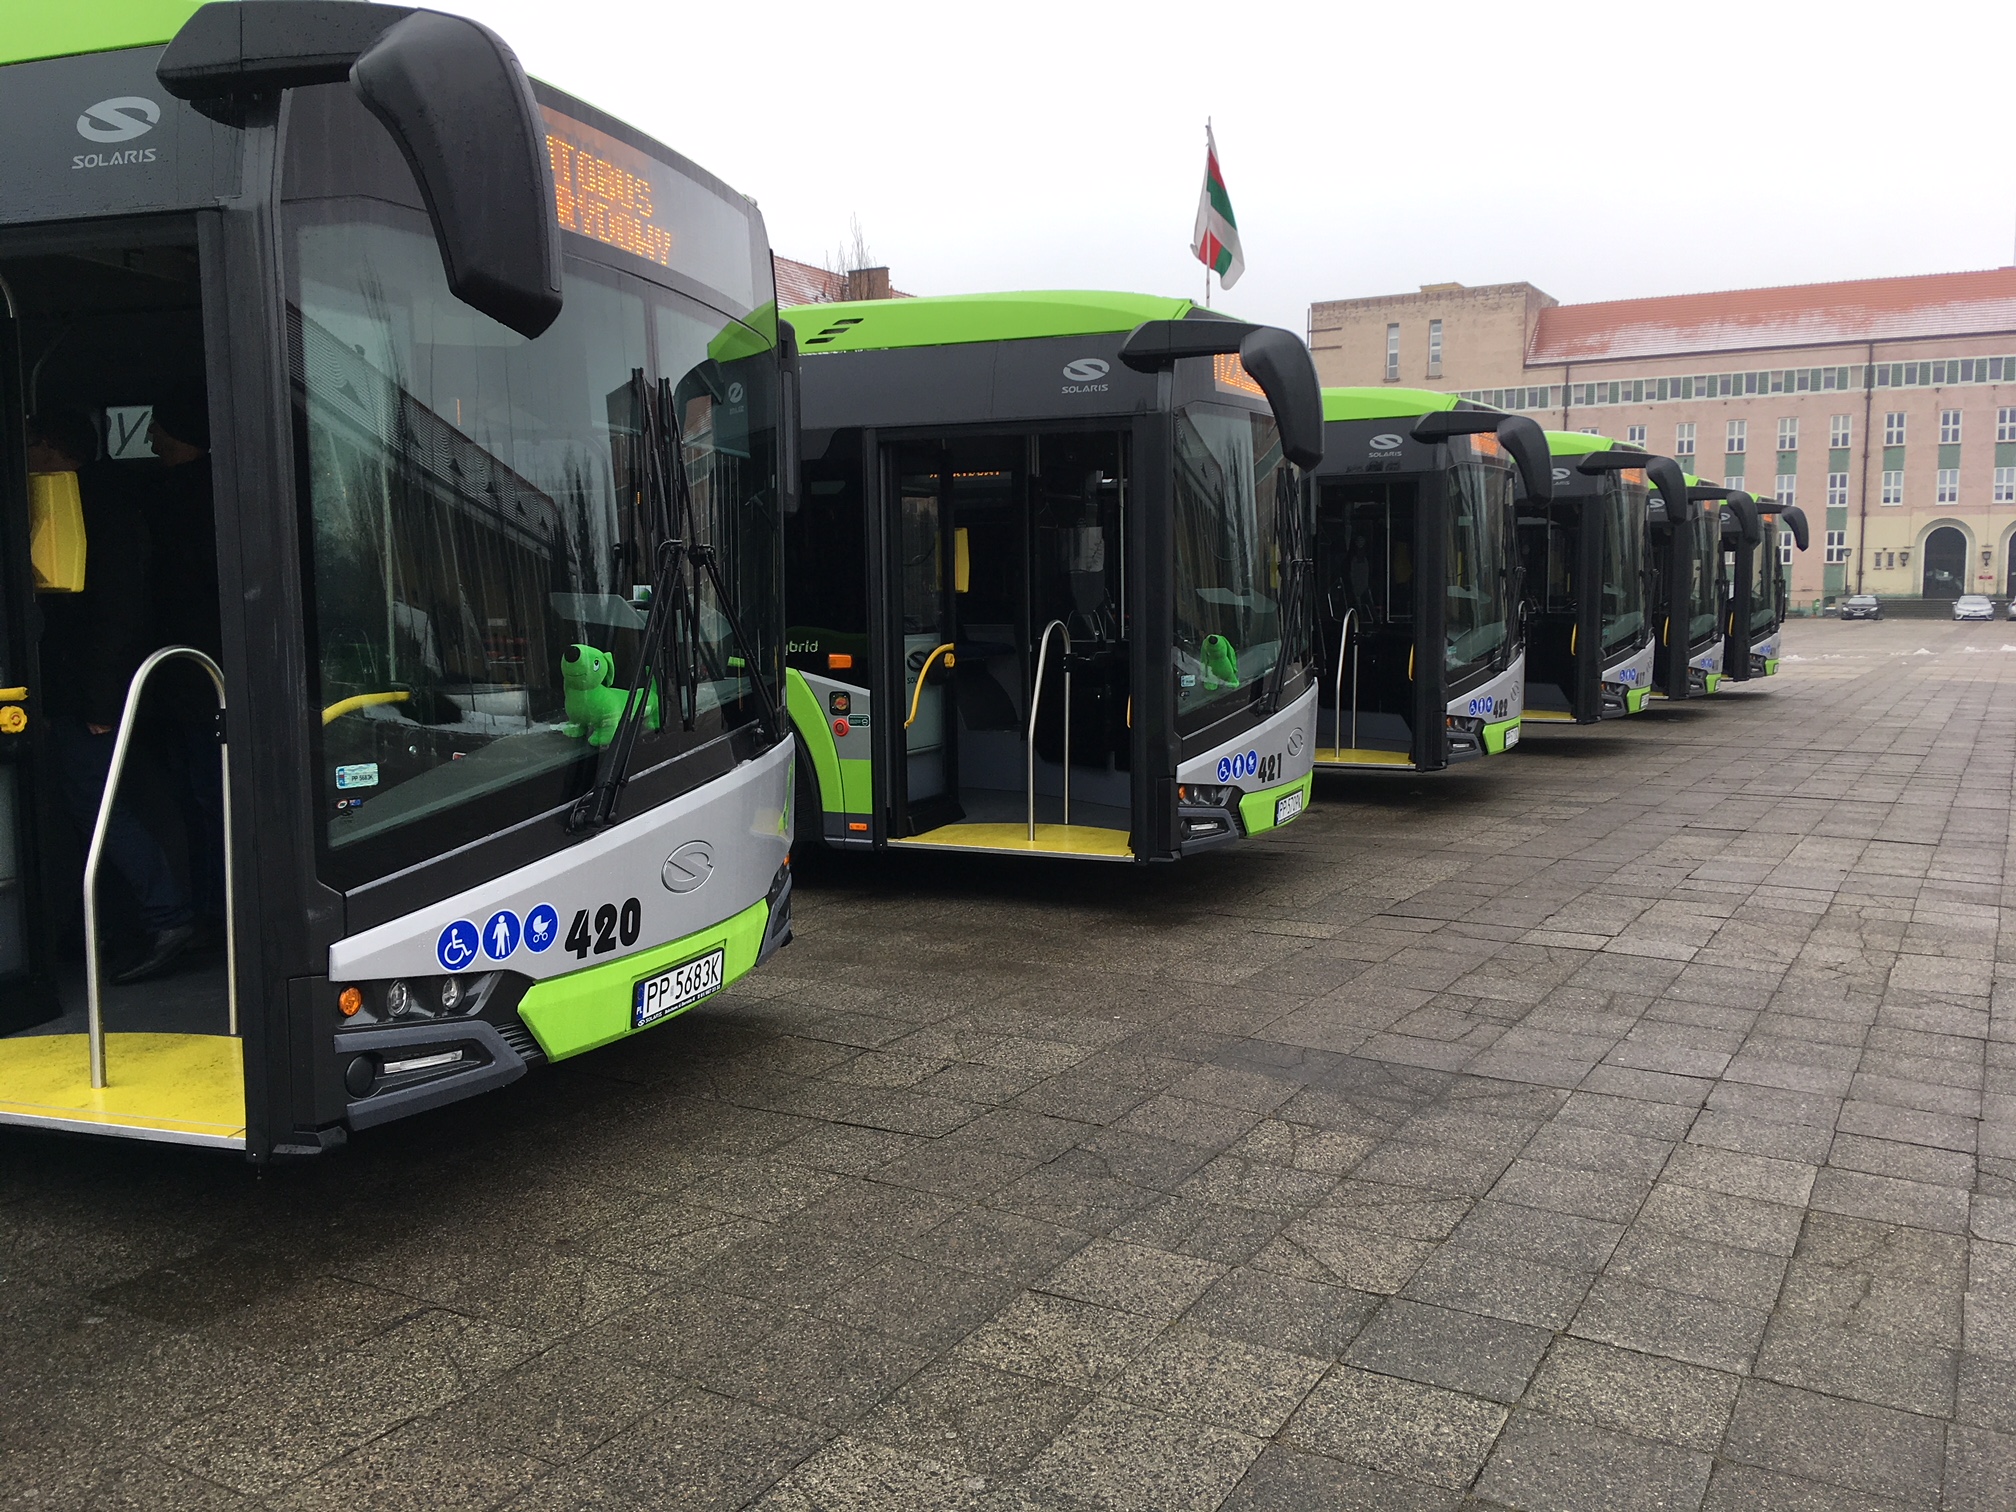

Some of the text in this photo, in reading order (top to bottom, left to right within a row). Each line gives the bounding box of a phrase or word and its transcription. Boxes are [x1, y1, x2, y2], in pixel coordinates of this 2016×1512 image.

[71, 148, 157, 169] SOLARIS
[1061, 383, 1109, 394] SOLARIS
[1368, 450, 1402, 458] SOLARIS
[1493, 698, 1507, 718] 422
[1258, 753, 1281, 783] 421
[564, 897, 641, 959] 420
[646, 976, 670, 1013] PP
[674, 954, 720, 1000] 5683K
